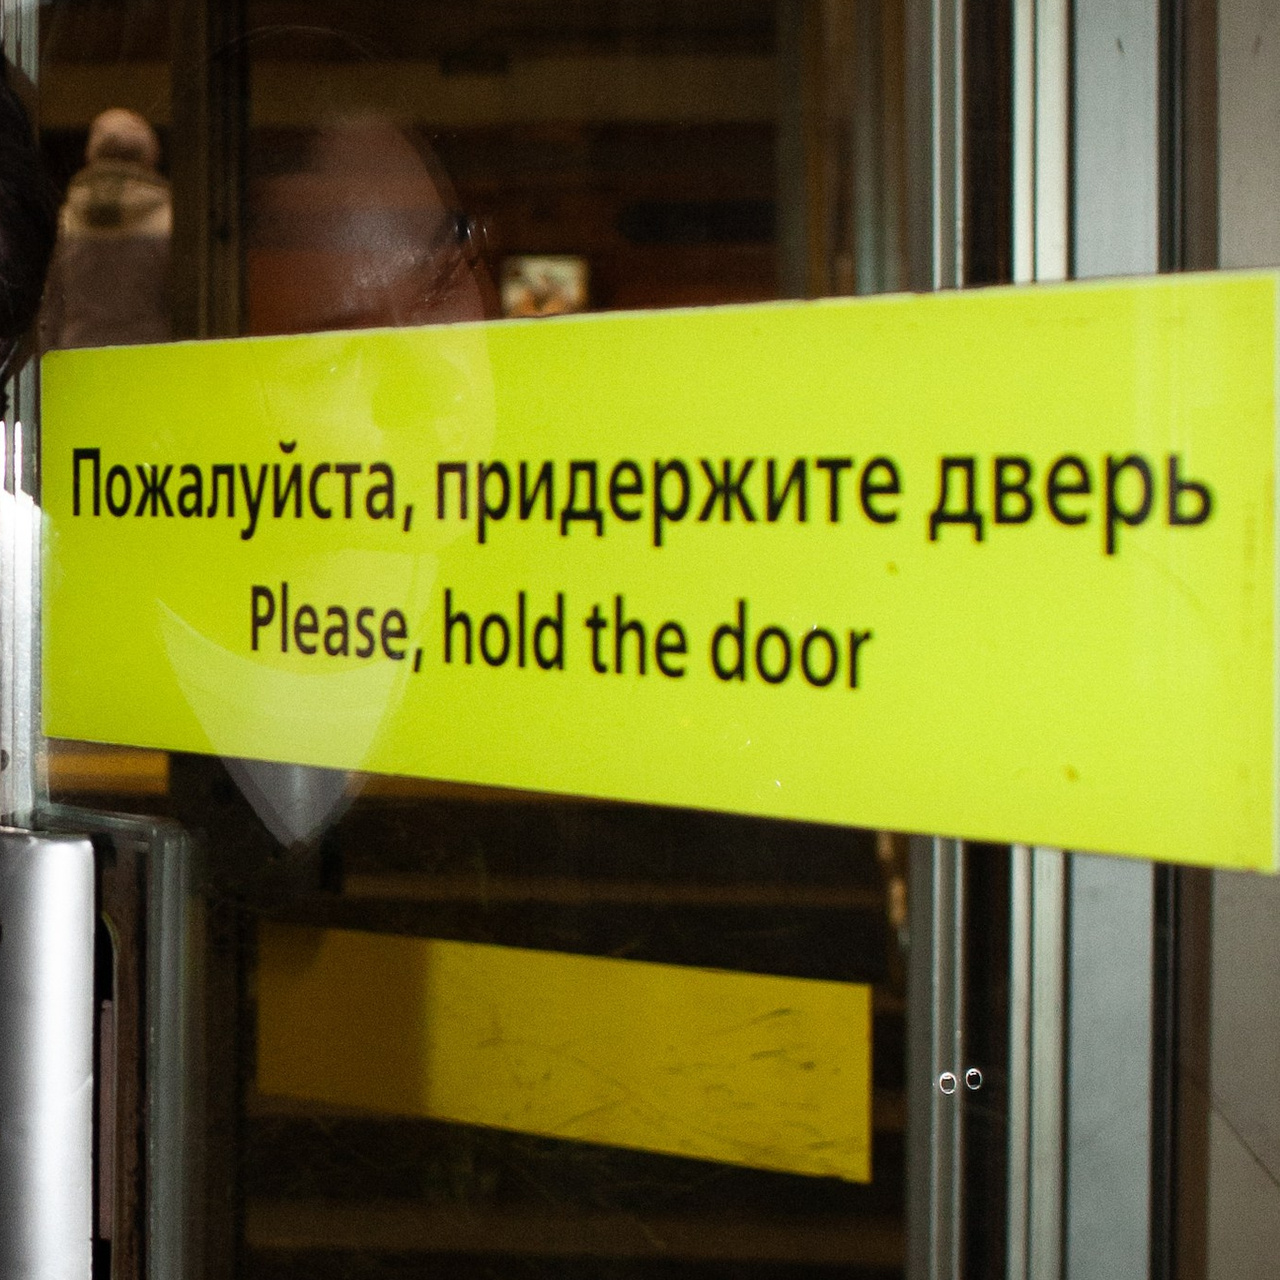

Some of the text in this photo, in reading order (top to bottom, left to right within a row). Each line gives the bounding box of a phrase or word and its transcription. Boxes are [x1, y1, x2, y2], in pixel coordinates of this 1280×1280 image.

[72, 440, 1214, 556] Пожалуйста, придержите дверь
[249, 581, 872, 689] Please, hold the door
